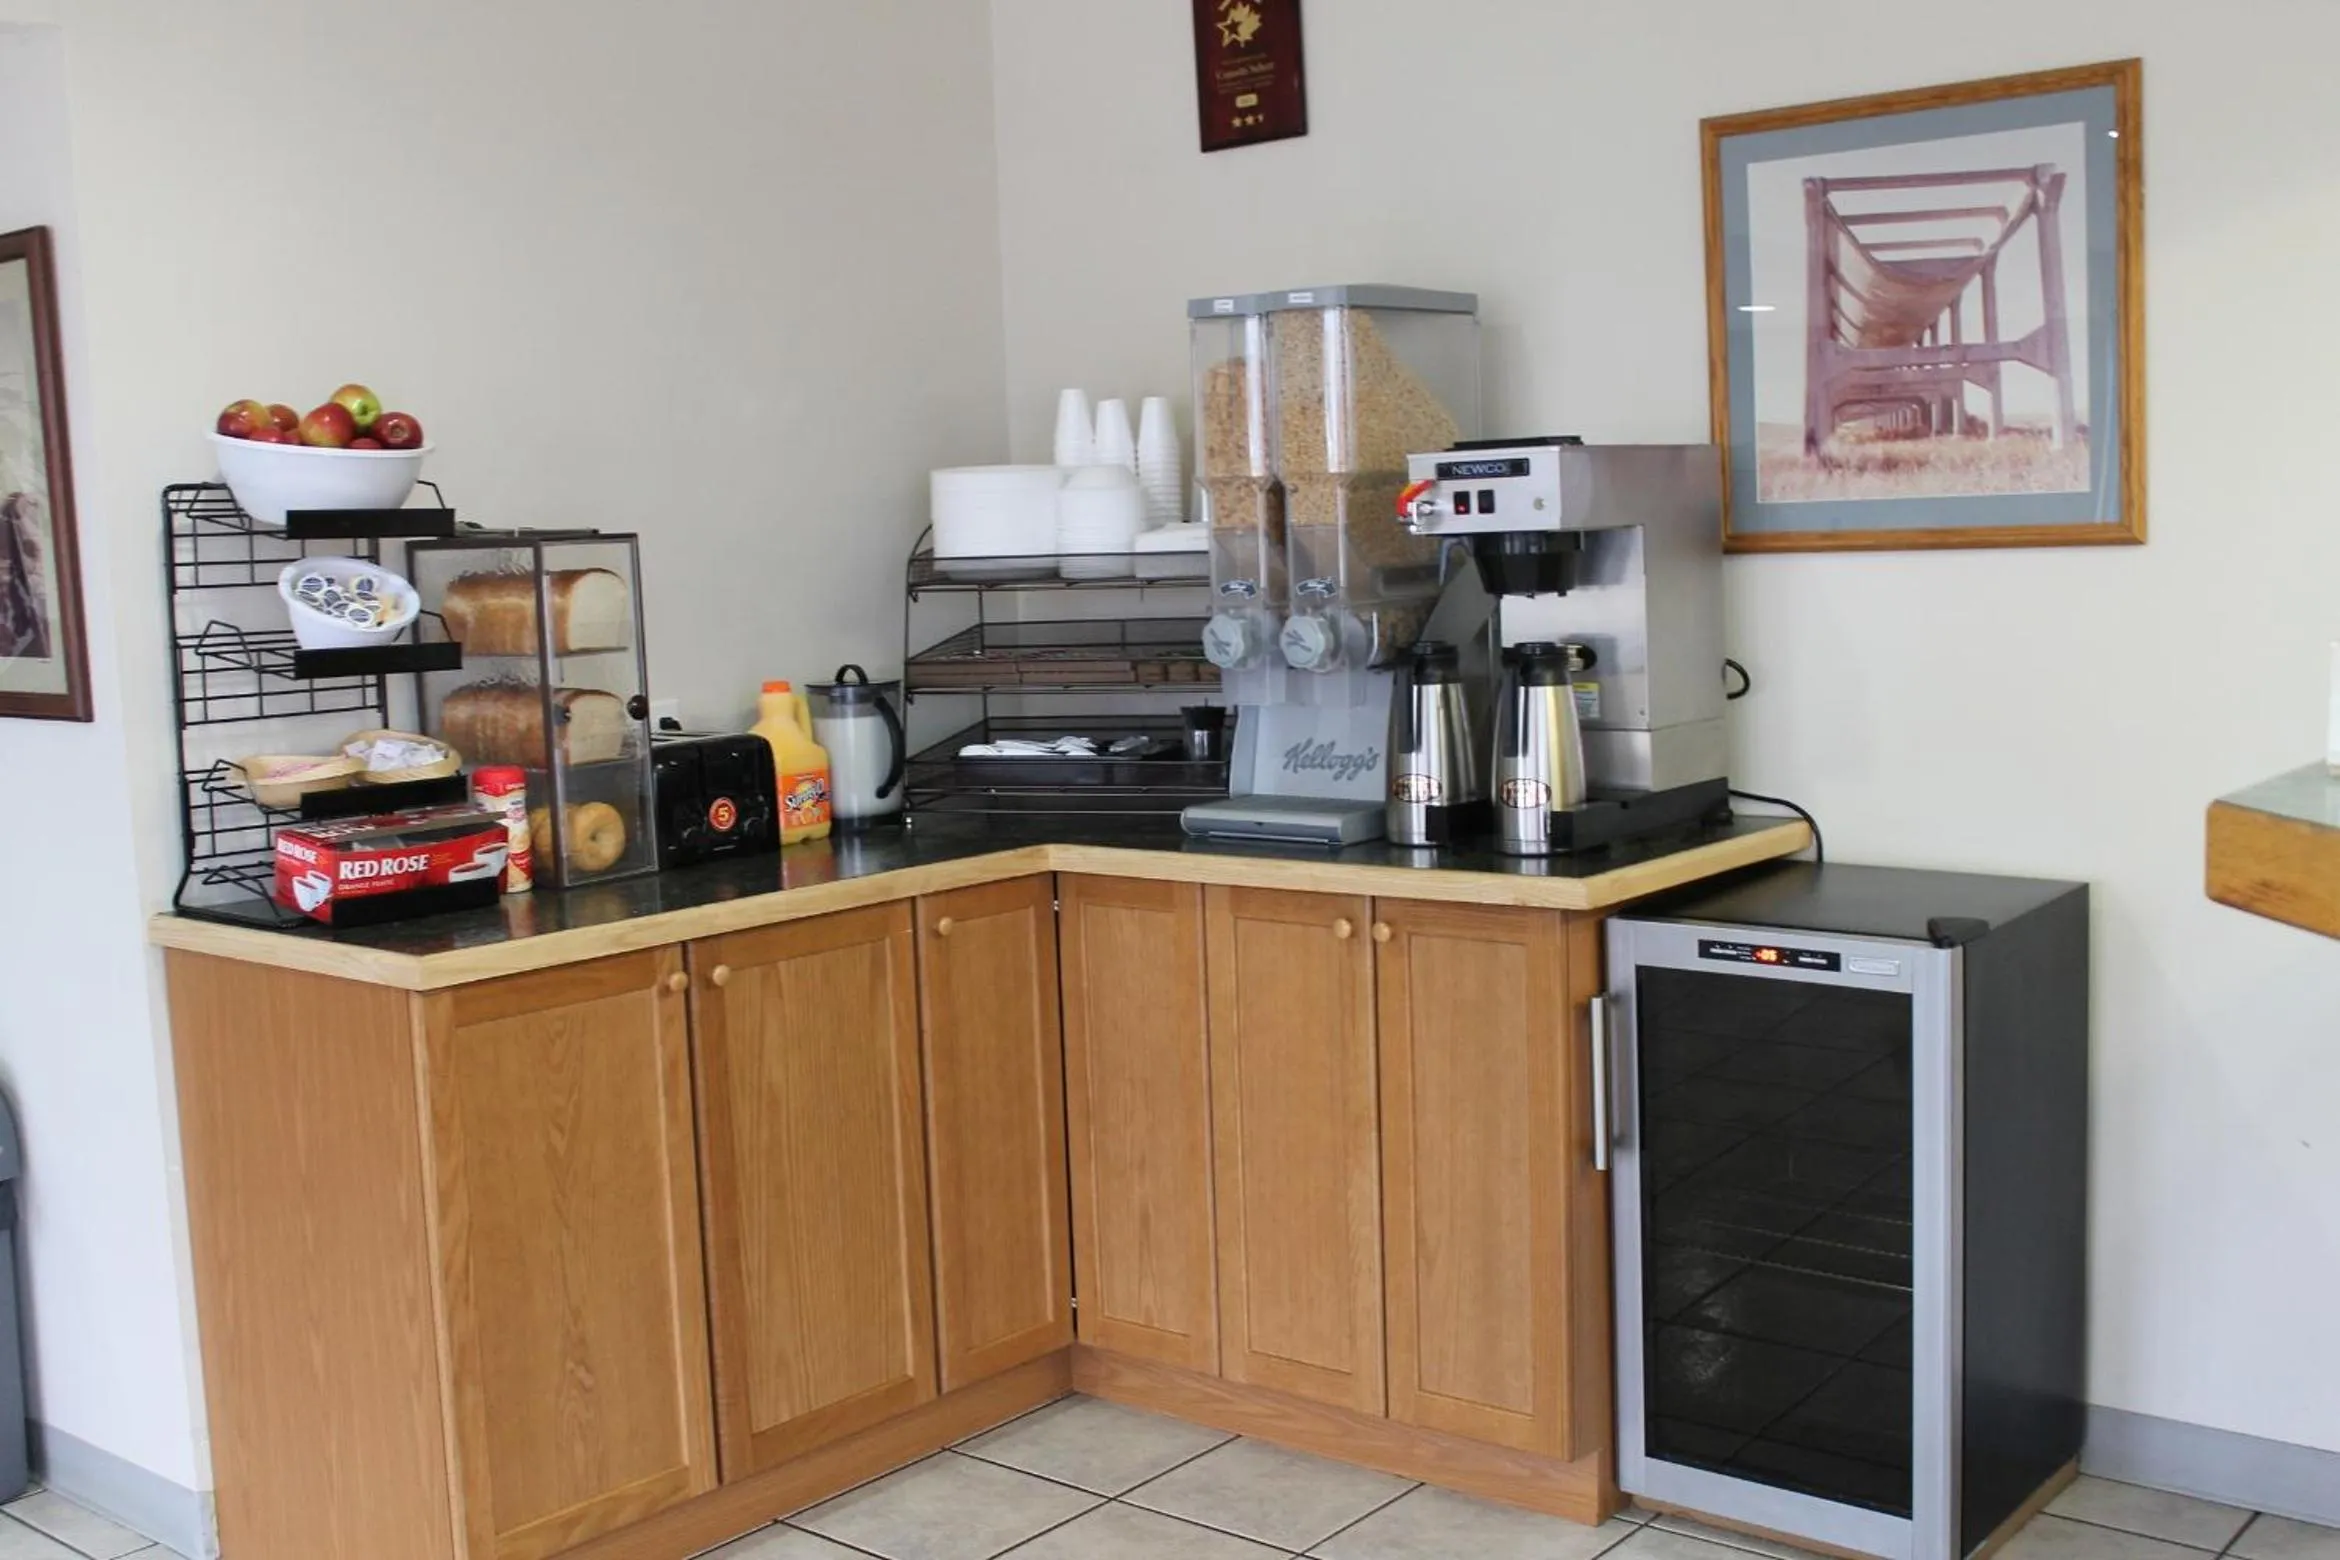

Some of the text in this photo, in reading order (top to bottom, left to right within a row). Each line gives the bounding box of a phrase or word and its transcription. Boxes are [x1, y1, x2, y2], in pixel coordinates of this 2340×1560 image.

[1452, 463, 1507, 475] NEWCO
[1283, 738, 1379, 780] Kellogg's
[718, 807, 729, 821] 5
[339, 860, 380, 880] RED
[380, 854, 430, 876] ROSE
